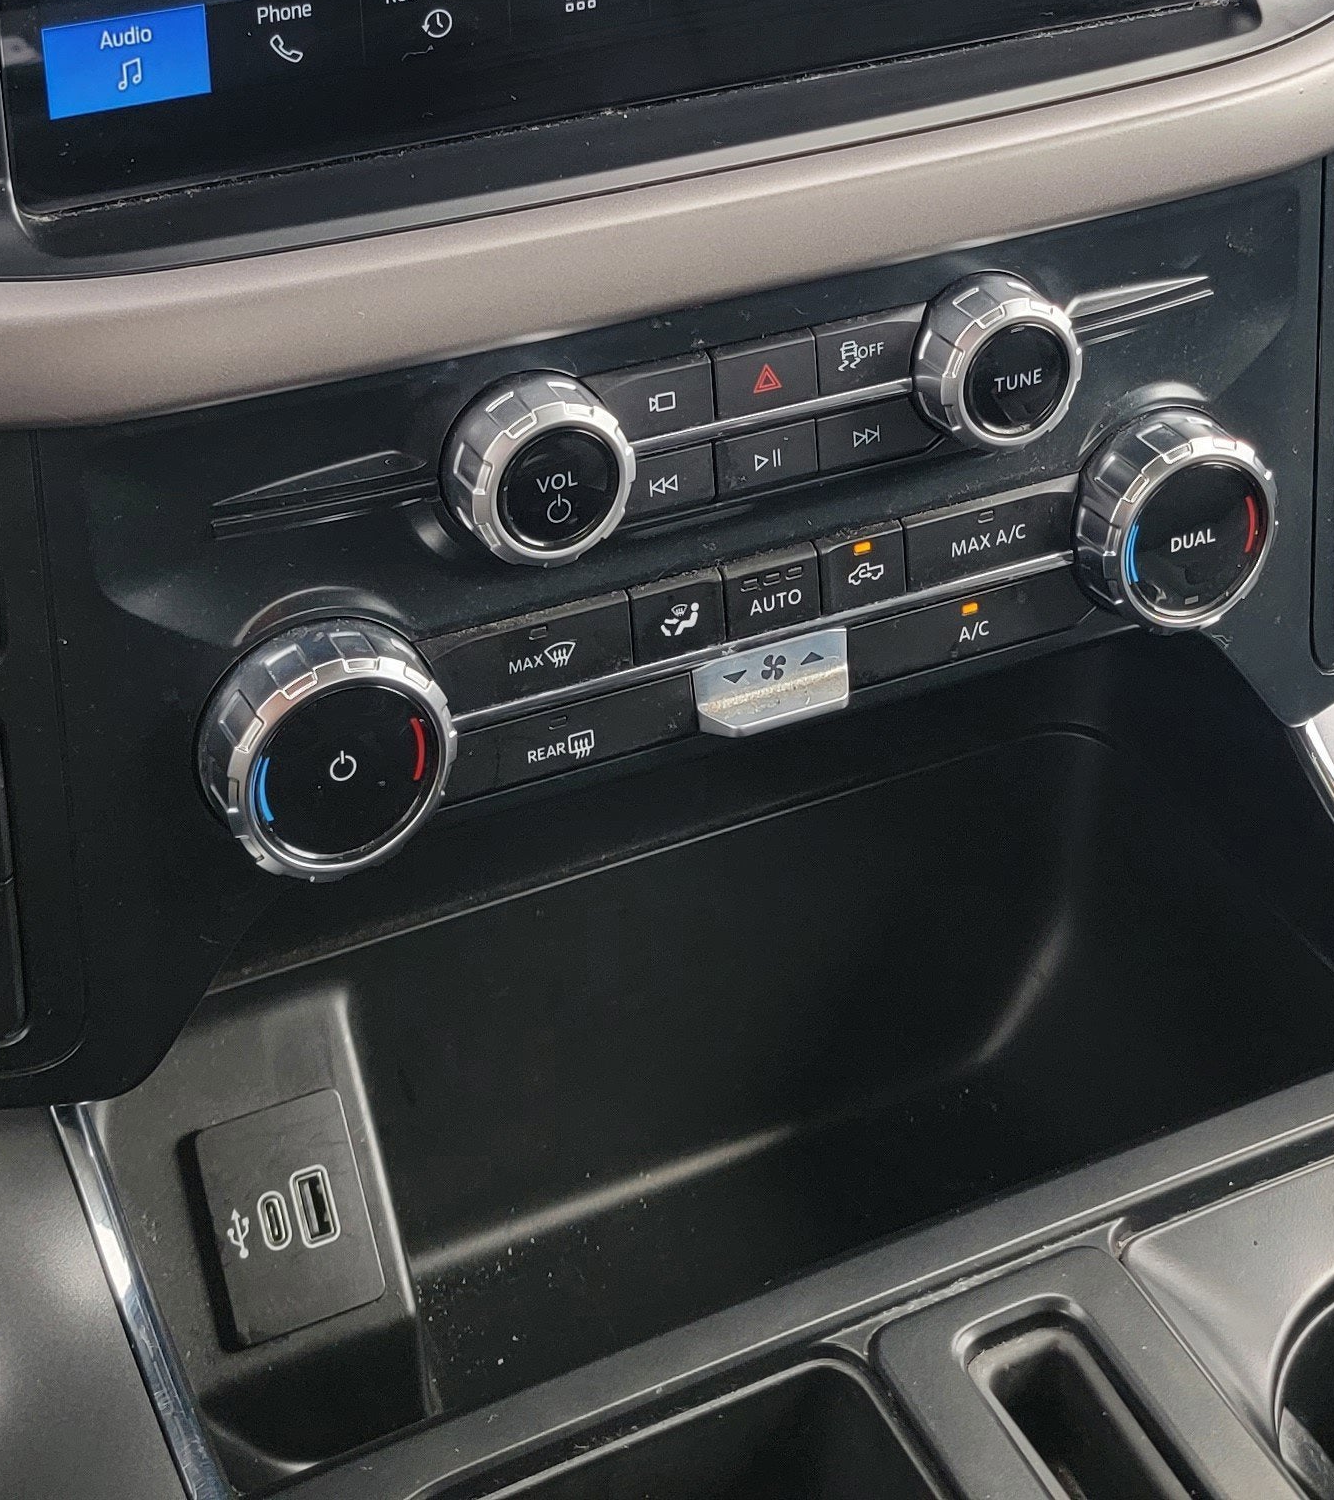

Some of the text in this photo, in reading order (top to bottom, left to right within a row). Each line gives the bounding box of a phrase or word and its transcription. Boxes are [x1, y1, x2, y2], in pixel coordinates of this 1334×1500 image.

[257, 2, 312, 25] Phone
[99, 25, 152, 50] Audio
[858, 341, 885, 359] OFF
[994, 368, 1043, 393] TUNE
[536, 471, 578, 494] VOL
[951, 522, 1026, 558] MAX A/C
[1170, 527, 1216, 553] DUAL
[750, 588, 802, 617] AUTO
[958, 620, 990, 643] A/C
[508, 654, 544, 675] MAX
[527, 742, 566, 764] REAR
